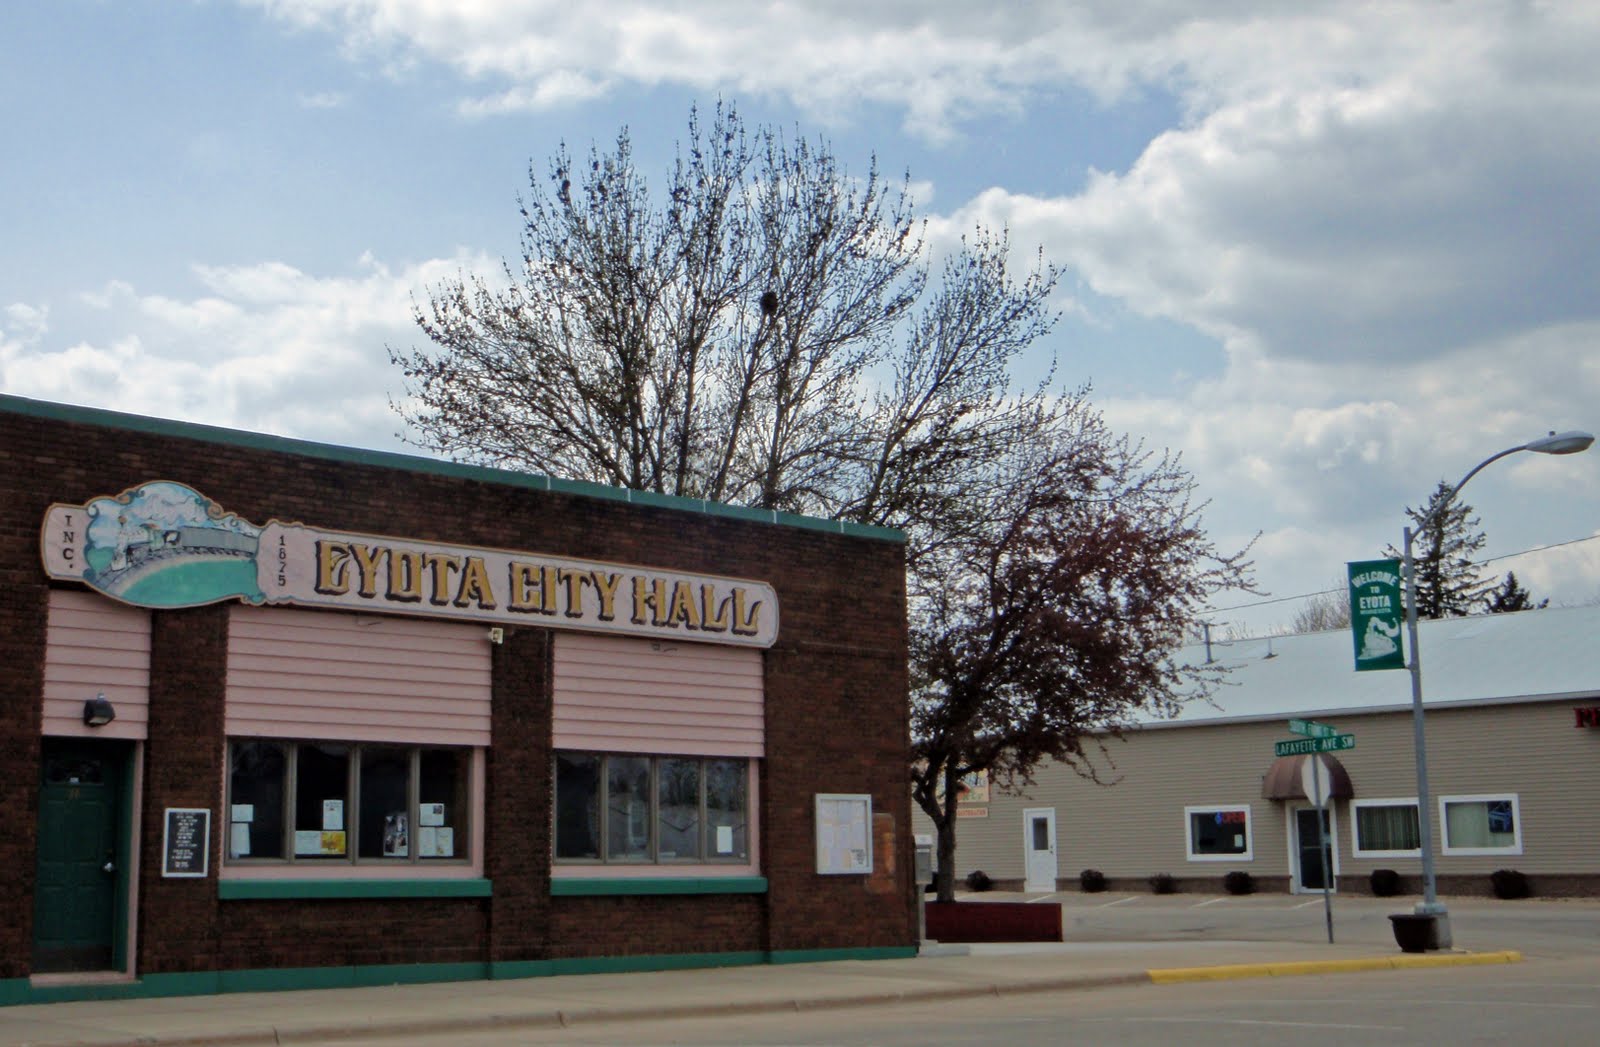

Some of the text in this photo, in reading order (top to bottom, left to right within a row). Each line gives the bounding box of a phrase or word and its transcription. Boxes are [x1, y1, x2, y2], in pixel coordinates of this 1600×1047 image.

[62, 514, 75, 569] INC.
[314, 540, 763, 637] EYOTA CITY HALL
[1352, 571, 1398, 588] WELCOME
[1369, 586, 1380, 594] TO
[1359, 595, 1392, 609] EYOTA
[1276, 736, 1354, 755] LAFAYETTE AVE SW
